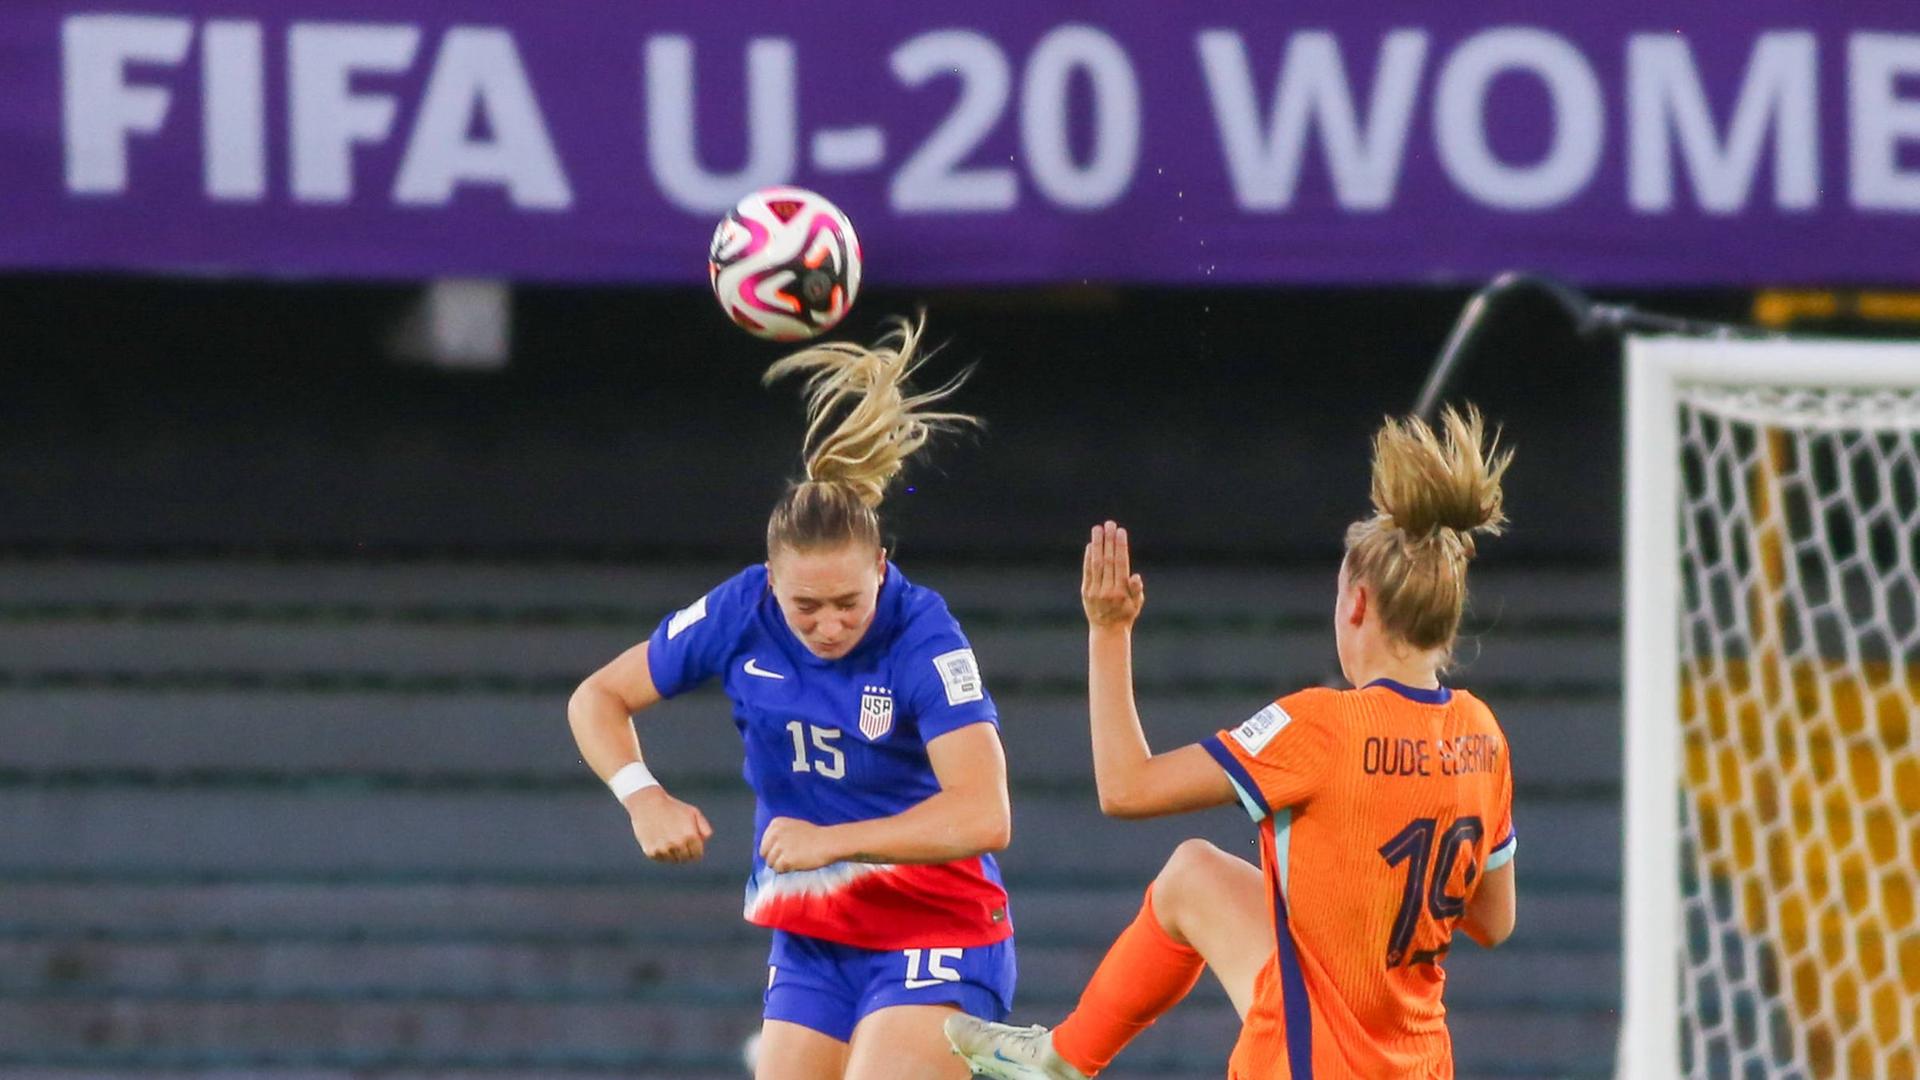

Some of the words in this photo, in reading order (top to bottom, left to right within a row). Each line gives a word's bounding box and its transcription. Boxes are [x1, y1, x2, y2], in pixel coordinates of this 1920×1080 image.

[61, 14, 574, 209] FIFA
[644, 25, 1141, 214] U-20
[1196, 25, 1920, 215] WOME
[863, 696, 891, 716] USA
[786, 720, 846, 780] 15
[1363, 736, 1430, 776] OUDE
[903, 948, 963, 982] 15
